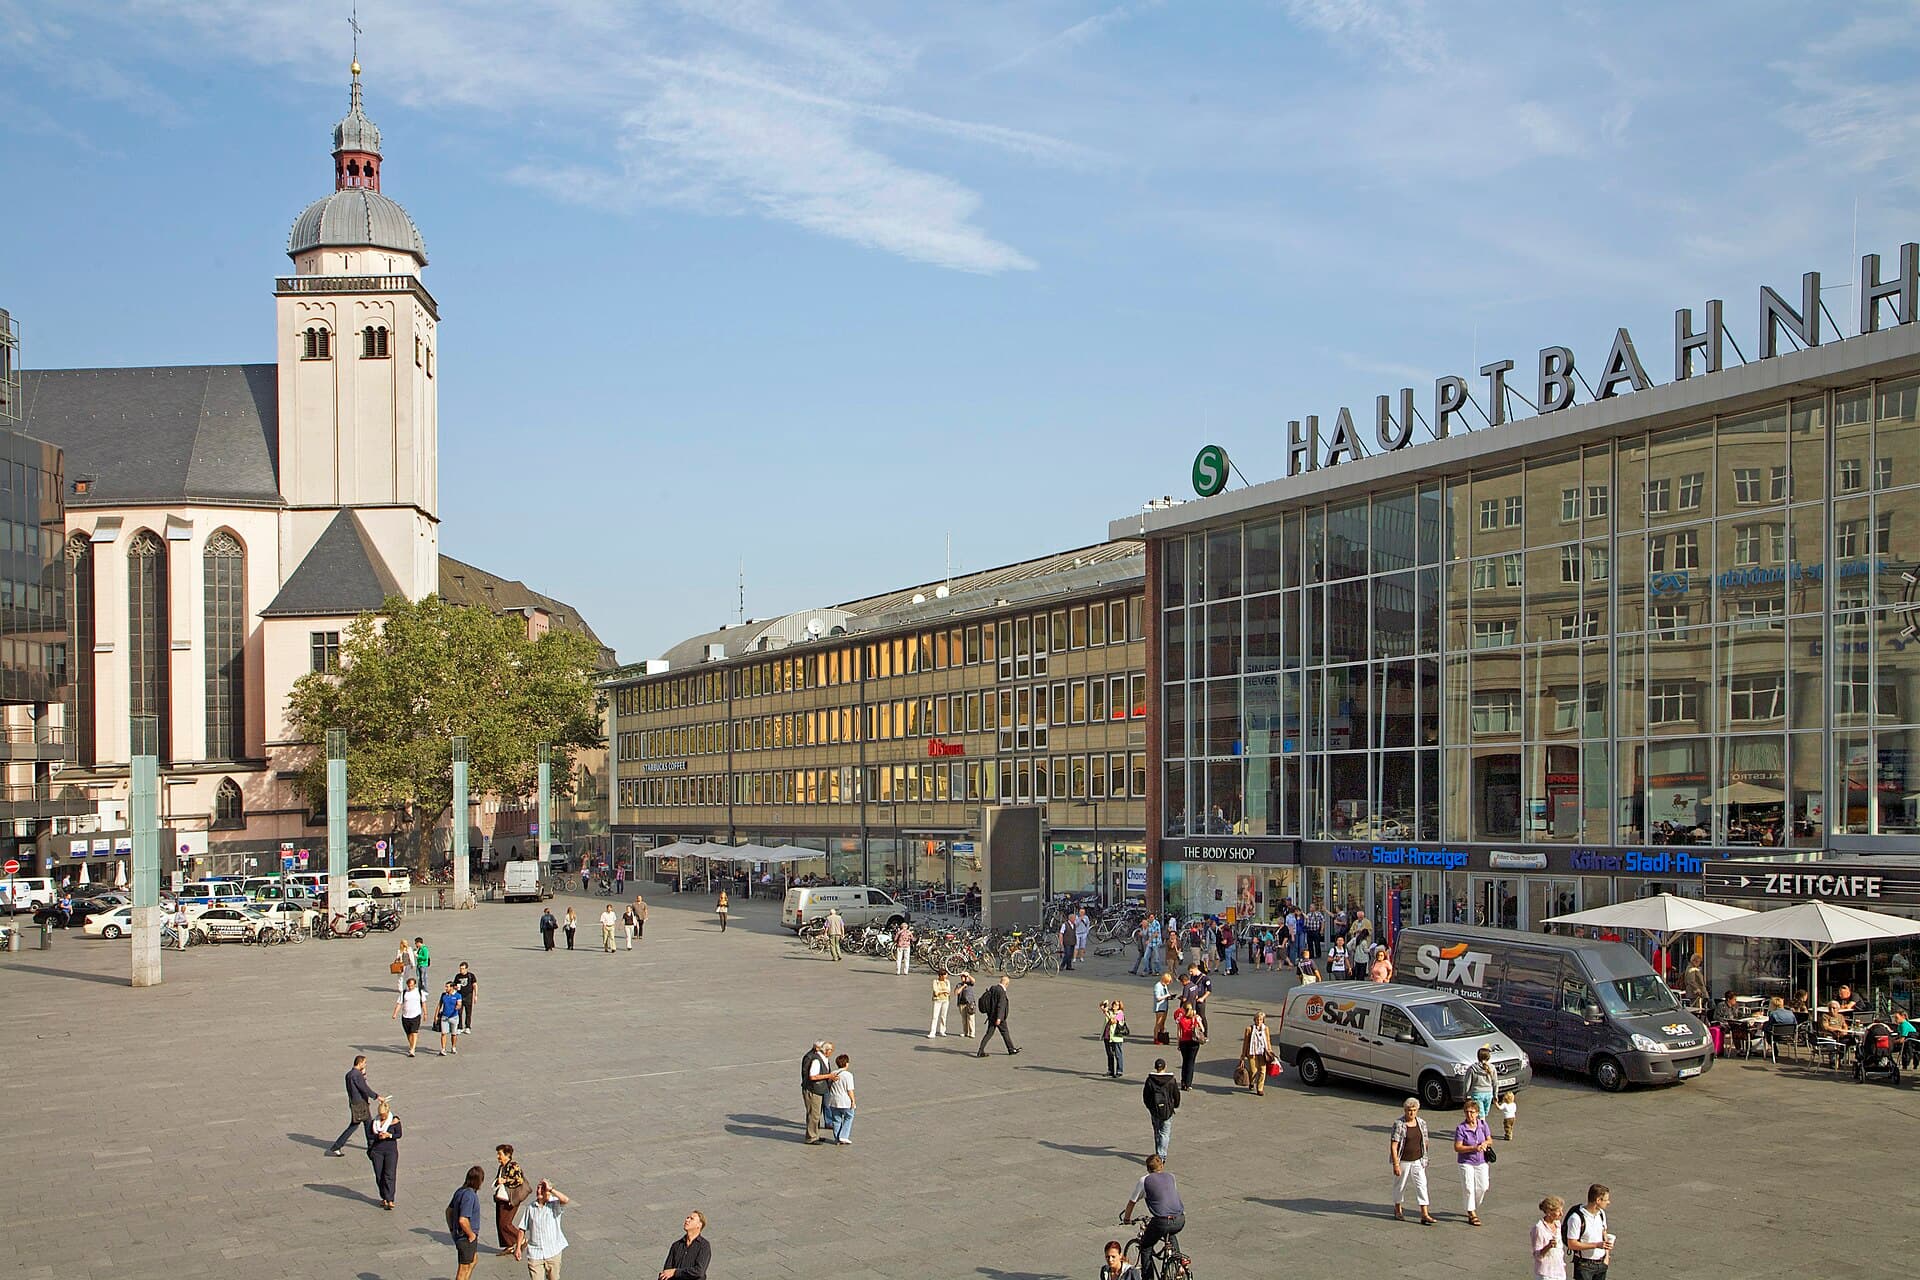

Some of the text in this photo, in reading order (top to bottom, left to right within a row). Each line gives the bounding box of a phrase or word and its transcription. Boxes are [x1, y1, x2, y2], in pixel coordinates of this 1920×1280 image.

[1287, 242, 1919, 476] HAUPTBAHNH
[1199, 452, 1217, 490] S
[669, 761, 688, 770] COFFEE
[1183, 846, 1255, 860] THE BODY SHOP
[1372, 846, 1469, 869] Stadt-Anzeiger
[1570, 850, 1703, 873] Kölner Stadt-An
[1461, 989, 1482, 999] truck
[1677, 1040, 1696, 1048] IVECO
